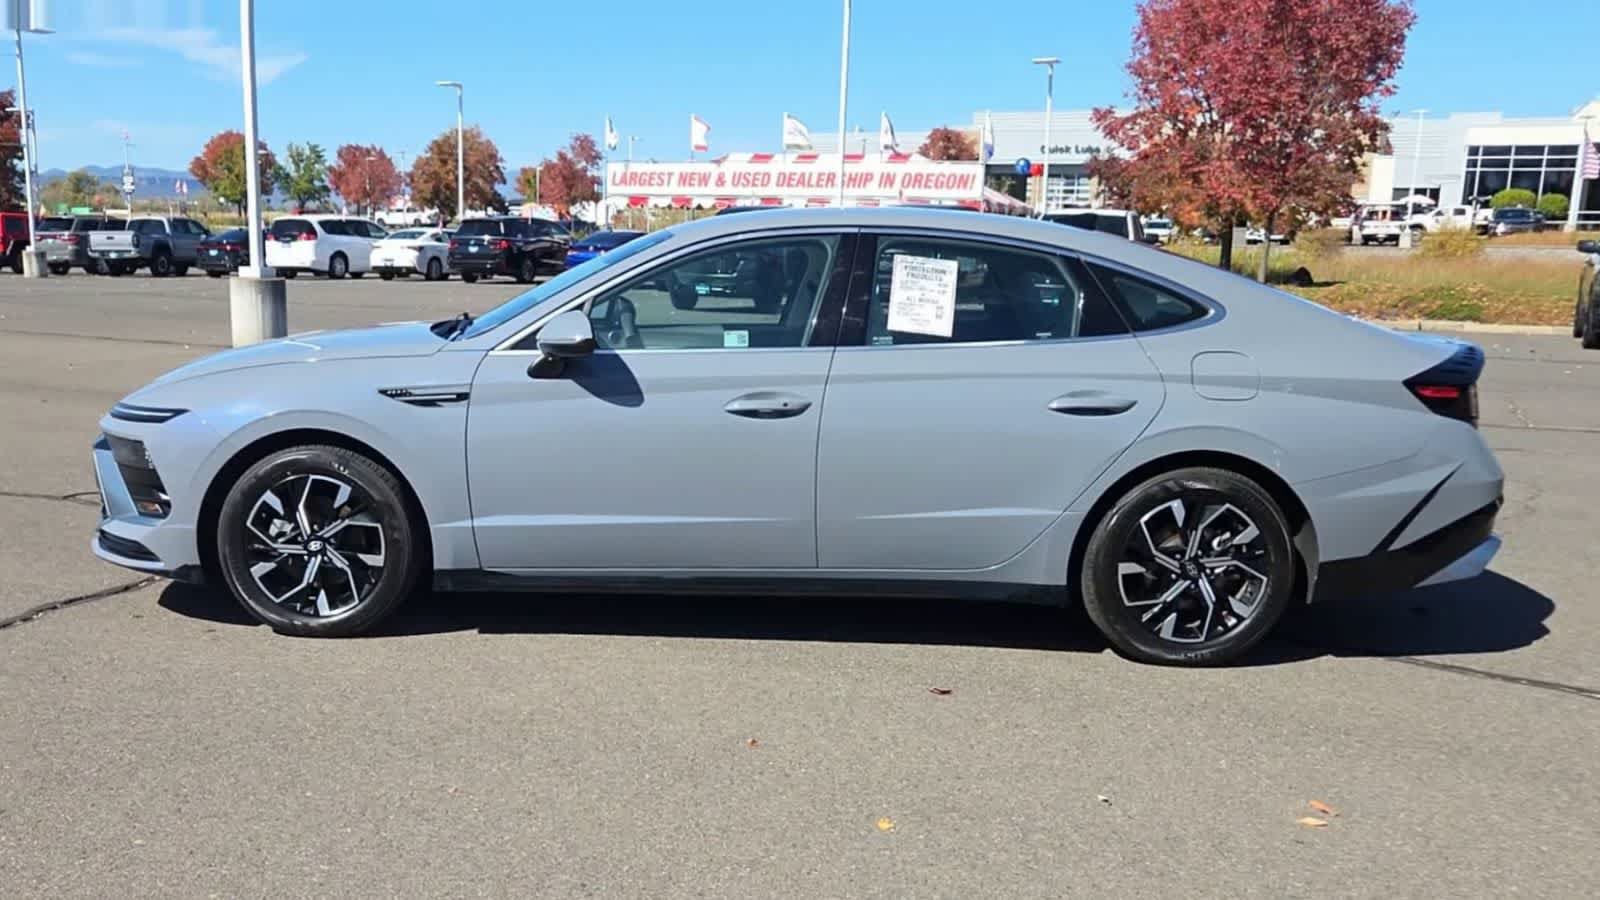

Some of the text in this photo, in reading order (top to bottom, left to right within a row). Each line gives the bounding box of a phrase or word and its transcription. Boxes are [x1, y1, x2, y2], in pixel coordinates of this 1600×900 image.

[611, 172, 977, 190] LARGEST NEW & USED DEALERHIP IN OREGON!
